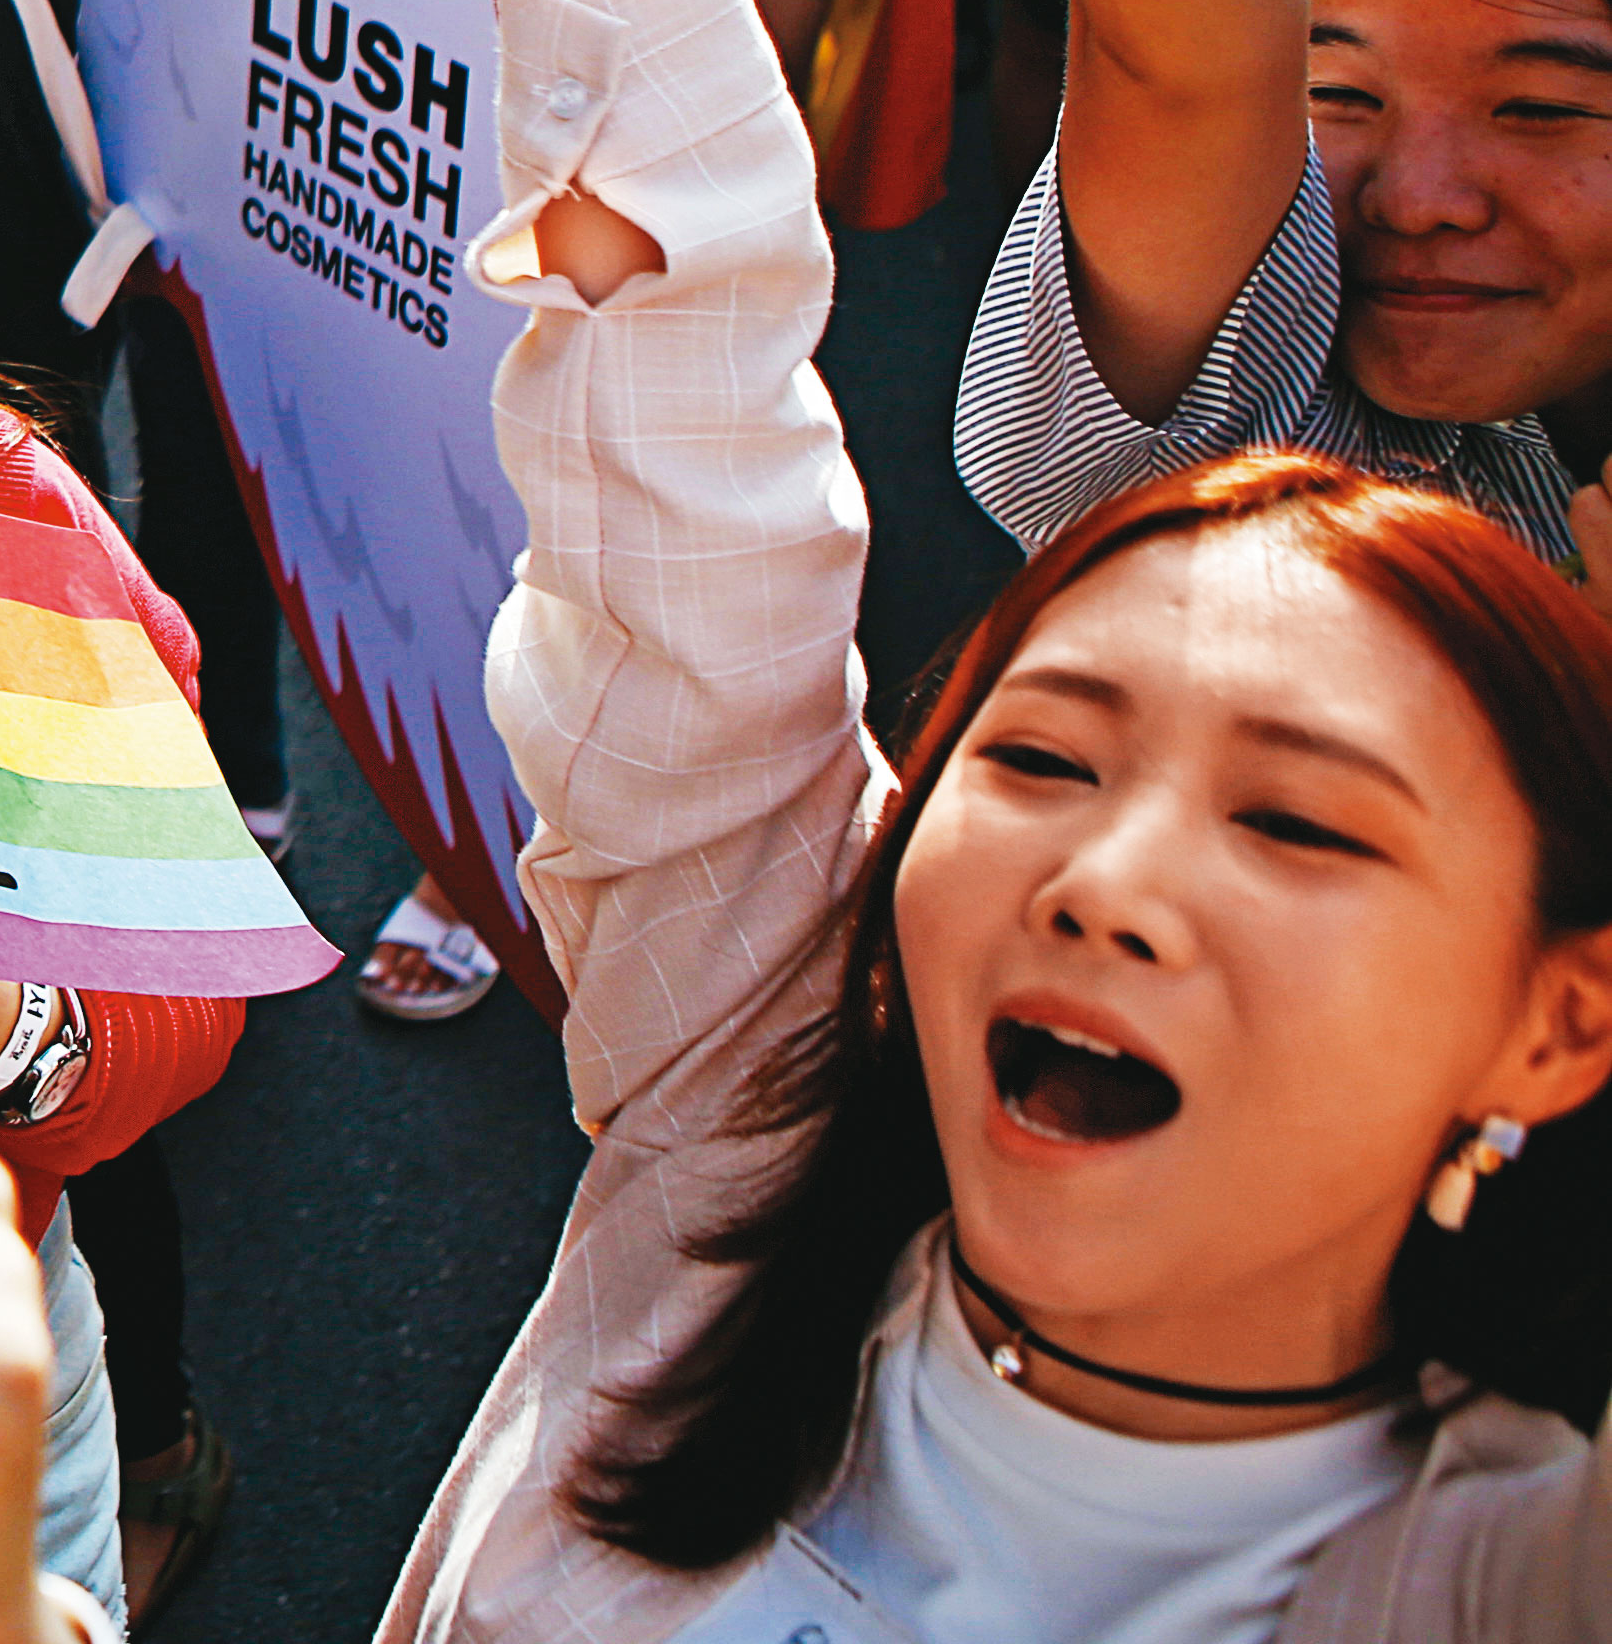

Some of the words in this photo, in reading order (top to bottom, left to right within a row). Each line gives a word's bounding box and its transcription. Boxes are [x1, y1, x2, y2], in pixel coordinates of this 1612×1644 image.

[243, 140, 456, 296] HANDMADE
[247, 59, 462, 239] FRESH
[241, 196, 450, 349] COSMETICS
